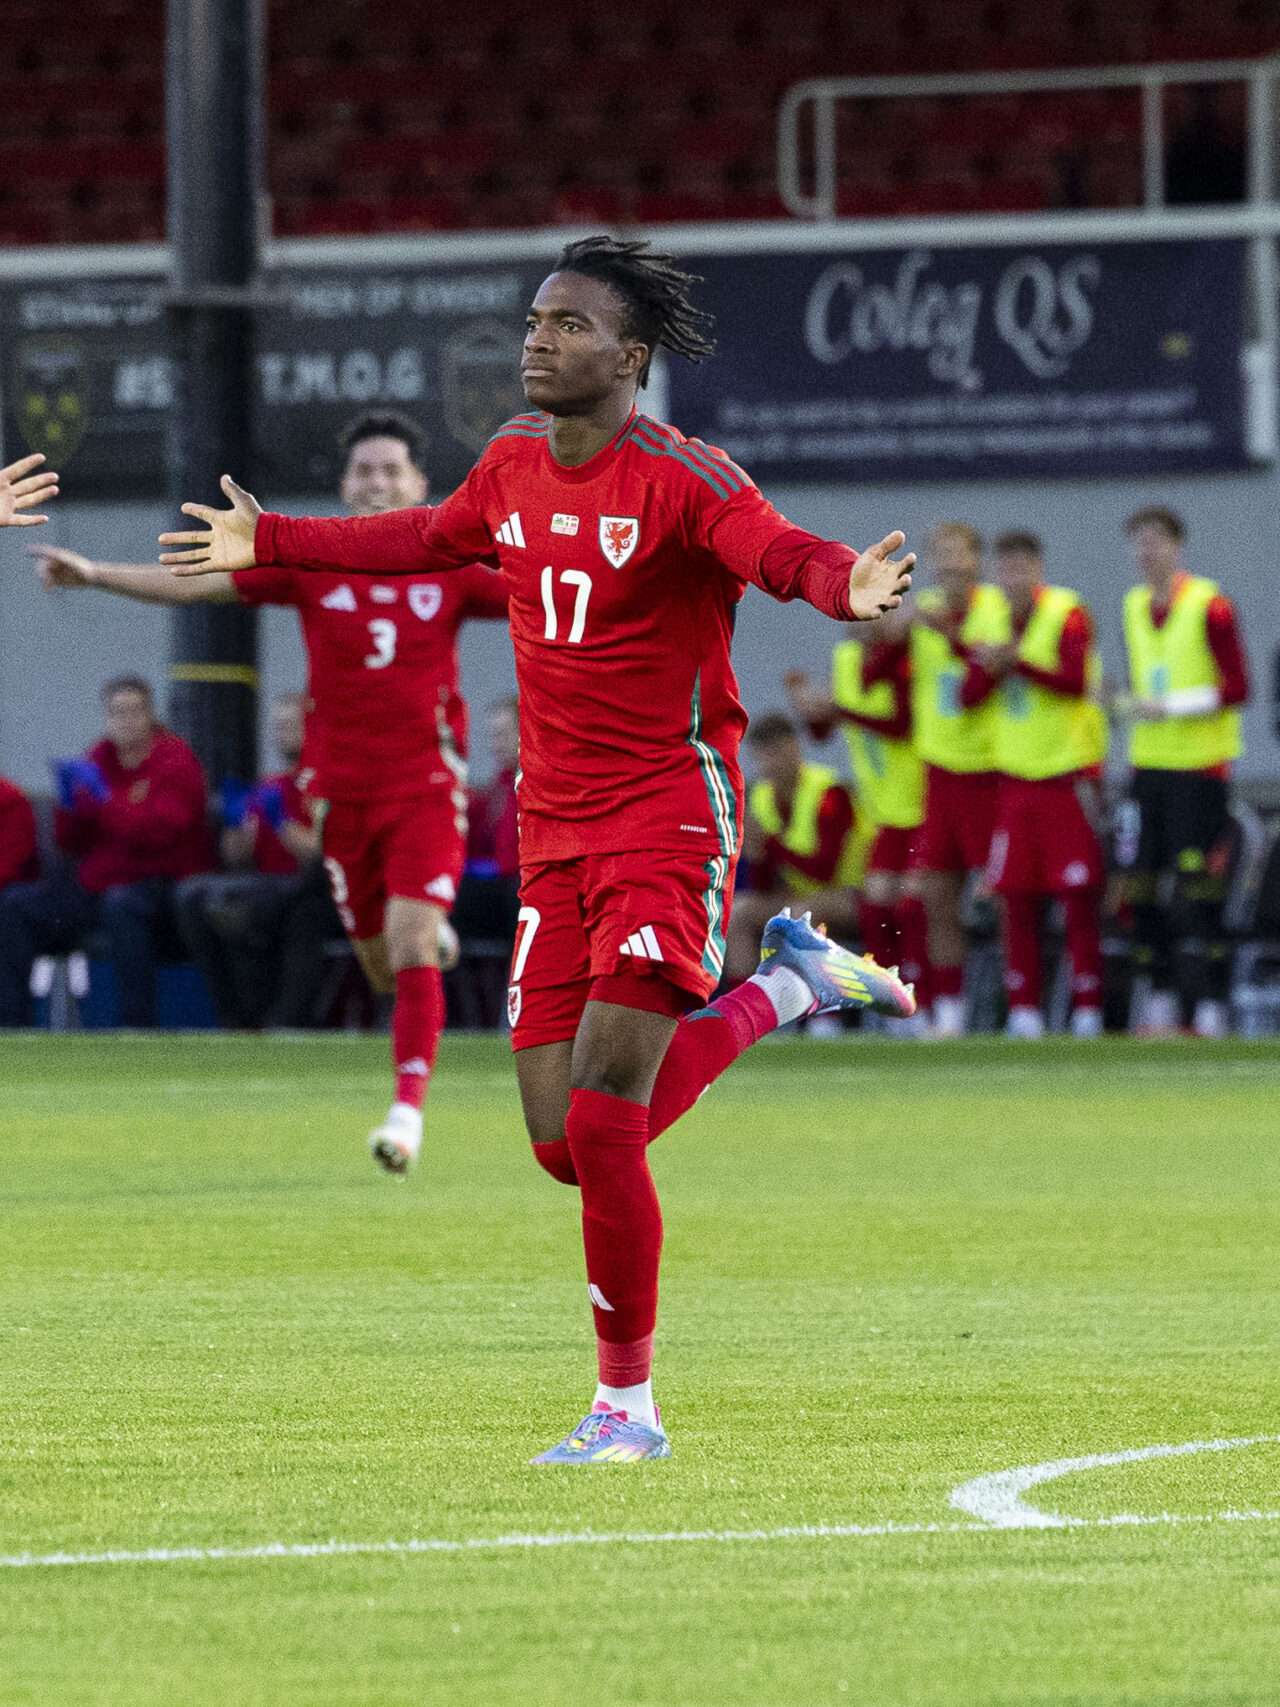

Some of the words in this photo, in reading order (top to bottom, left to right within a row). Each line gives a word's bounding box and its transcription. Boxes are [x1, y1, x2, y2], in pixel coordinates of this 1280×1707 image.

[995, 254, 1101, 378] QS
[541, 566, 592, 643] 17
[365, 618, 397, 669] 3
